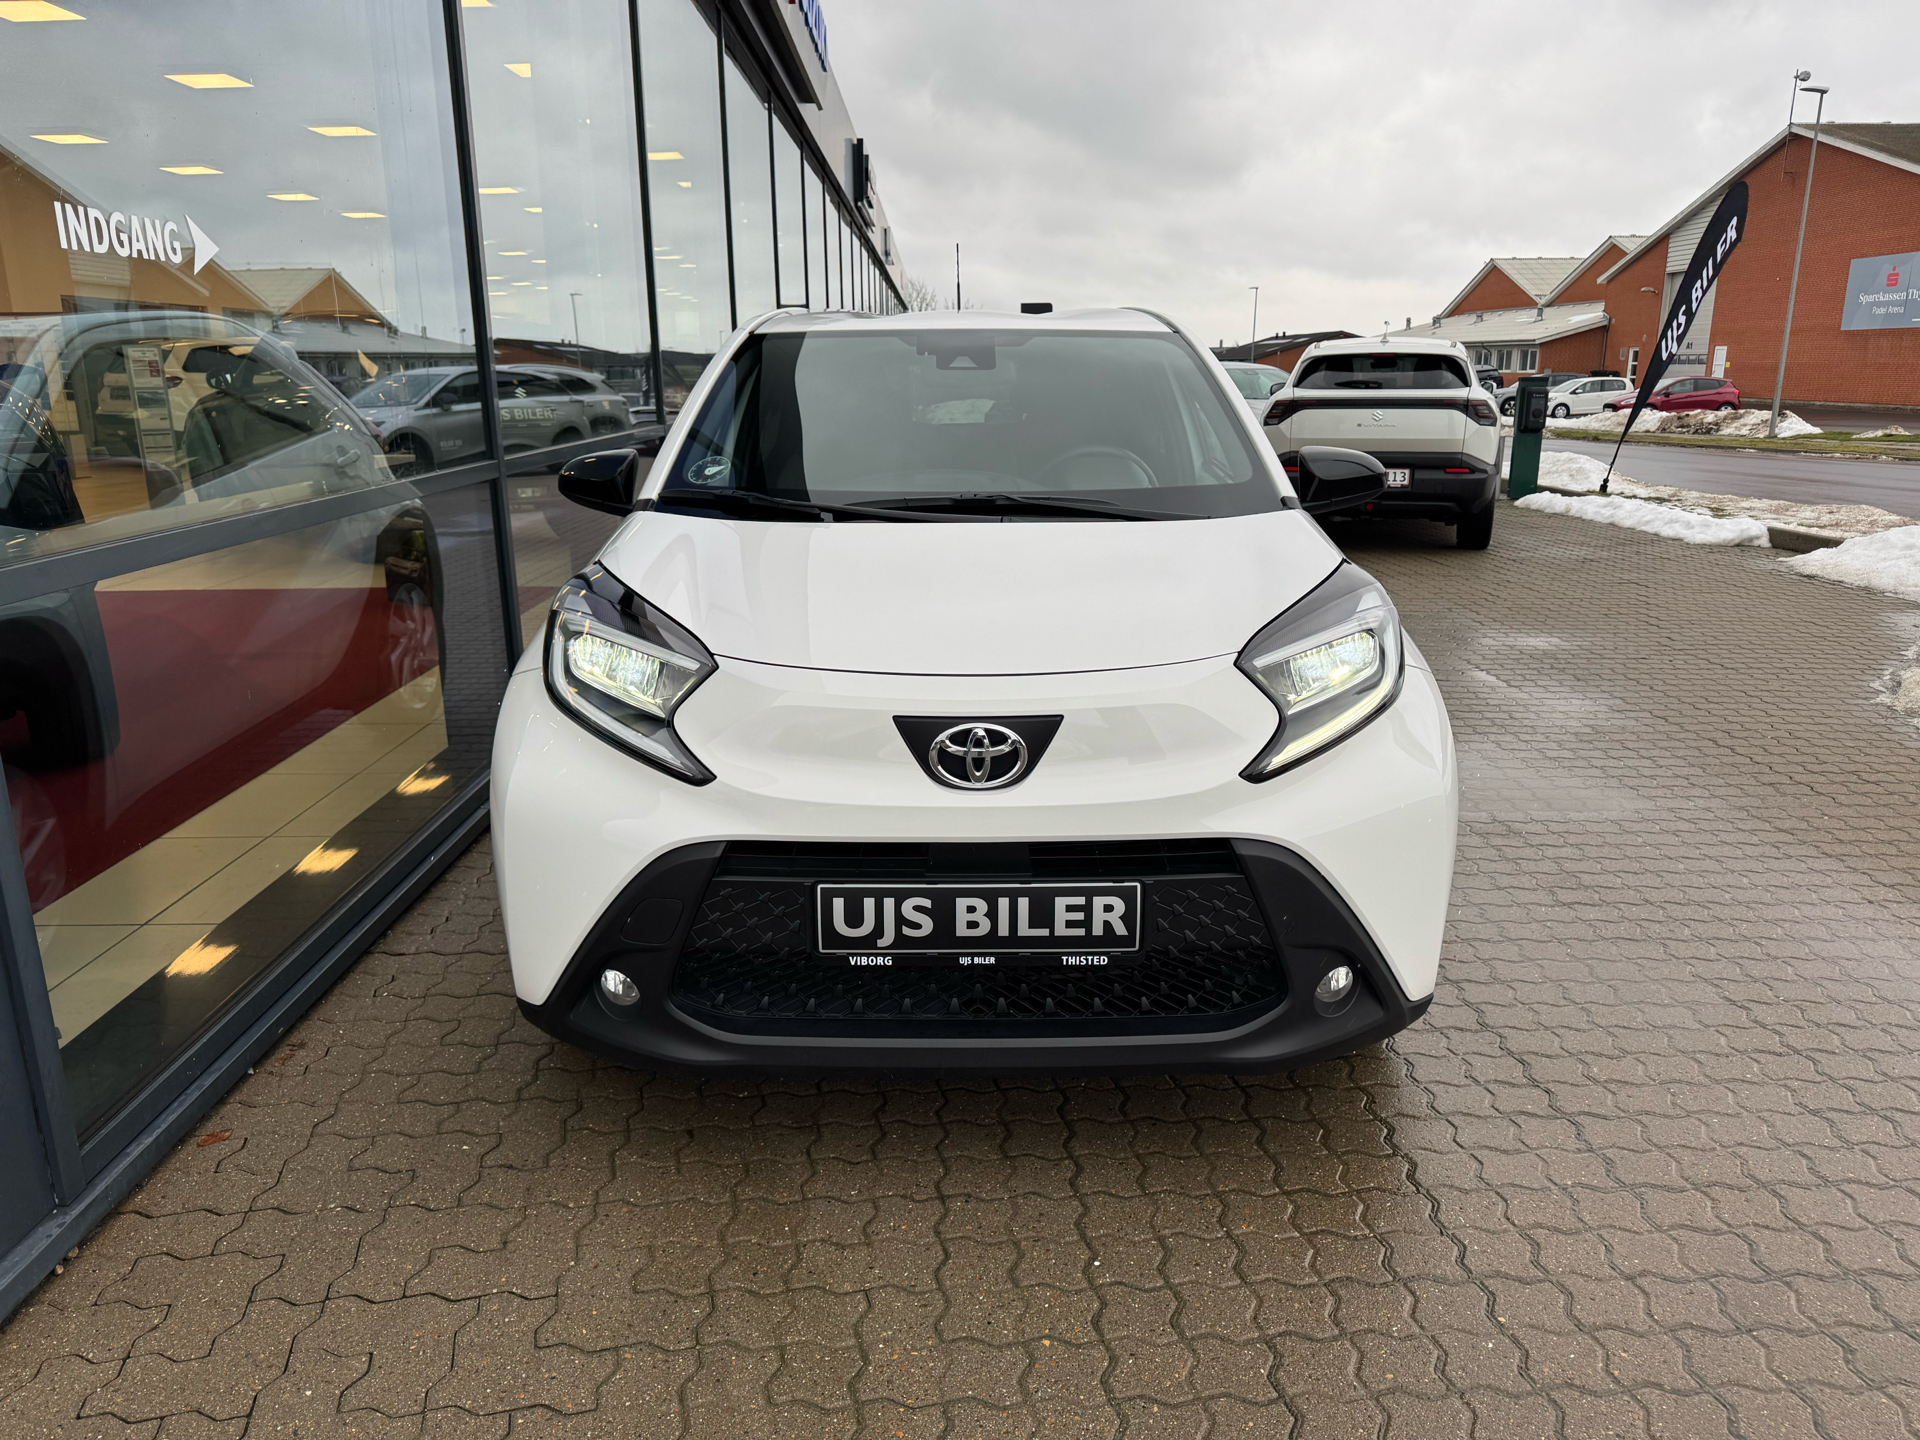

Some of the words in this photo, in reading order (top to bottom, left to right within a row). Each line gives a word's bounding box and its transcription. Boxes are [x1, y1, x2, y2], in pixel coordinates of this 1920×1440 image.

[53, 200, 183, 264] INDGANG
[1859, 291, 1906, 304] Sparekassen
[1872, 306, 1887, 314] Padel
[1888, 305, 1904, 313] Arena
[1661, 304, 1686, 361] UJS
[514, 408, 554, 421] BILER
[832, 897, 934, 948] UJS
[955, 896, 1129, 937] BILER
[849, 956, 893, 966] VIBORG
[959, 956, 972, 966] UJS
[973, 956, 996, 965] BILER
[1061, 956, 1108, 966] THISTED
